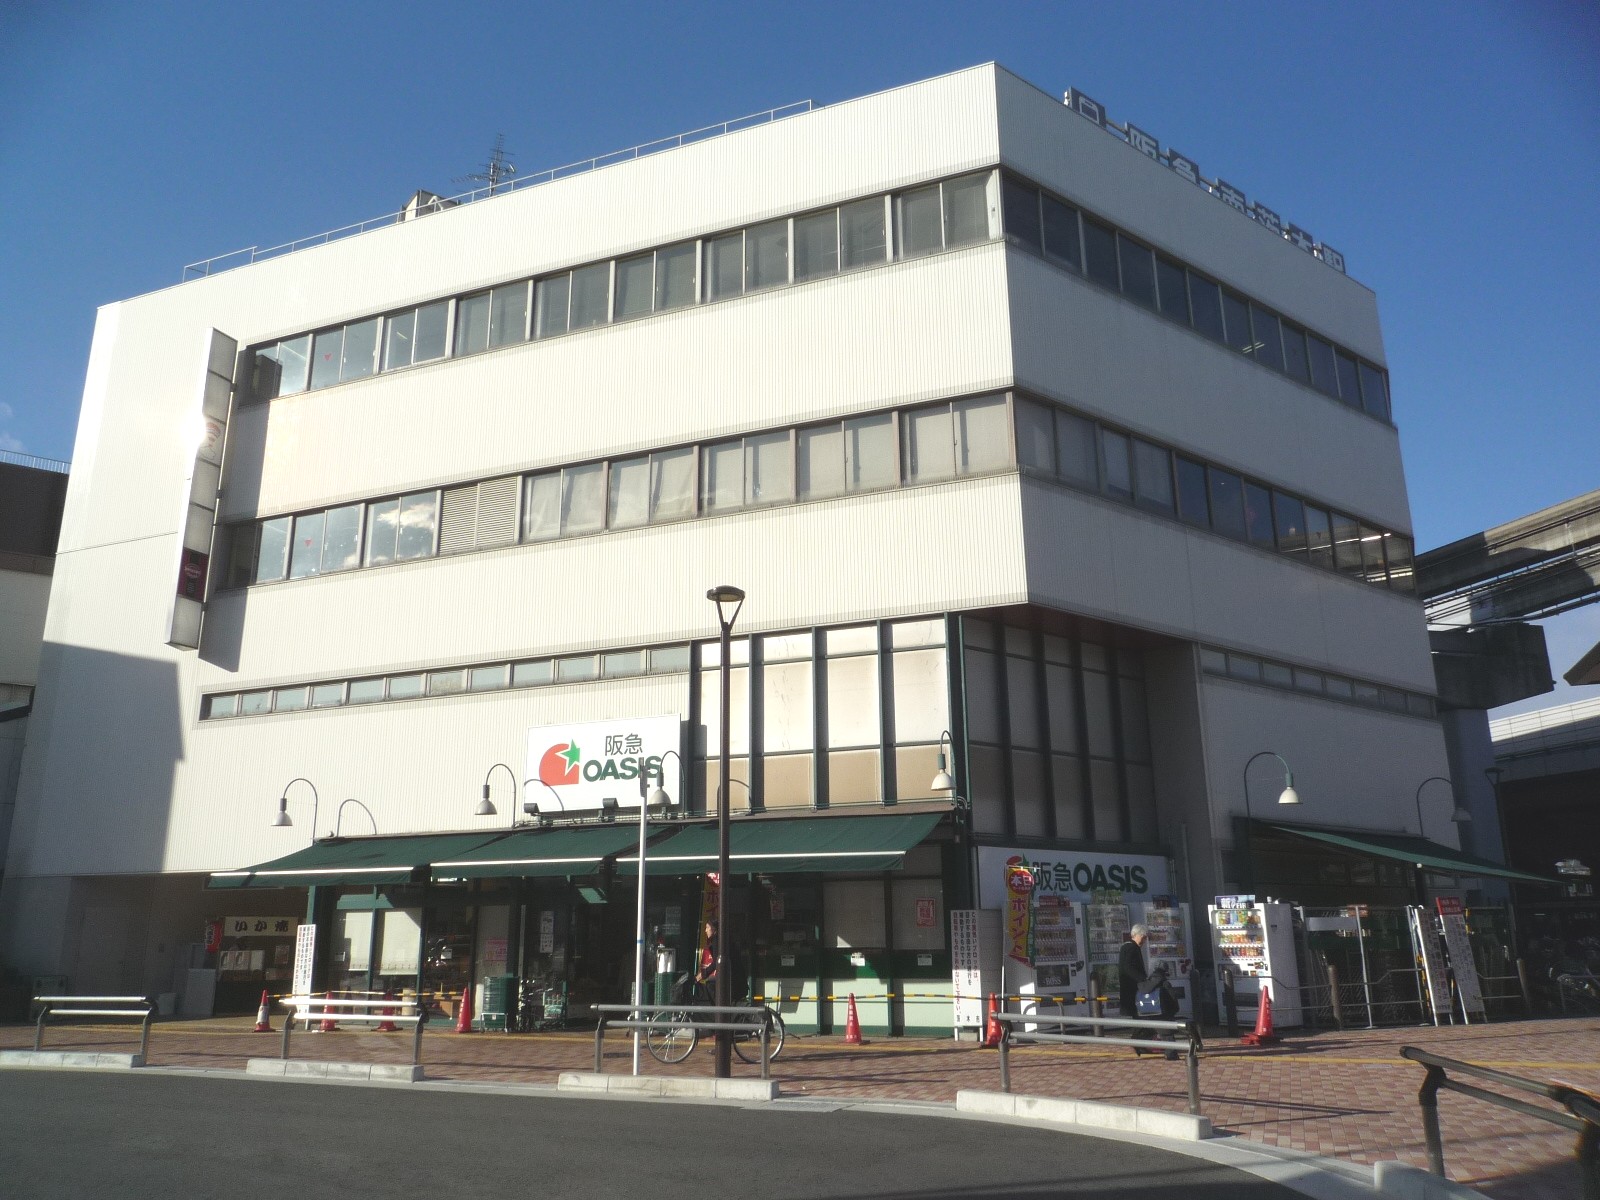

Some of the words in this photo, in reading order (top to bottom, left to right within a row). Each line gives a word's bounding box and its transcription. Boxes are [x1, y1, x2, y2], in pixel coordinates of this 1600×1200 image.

[605, 733, 643, 756] 阪急
[1032, 861, 1074, 892] 阪急
[1073, 863, 1149, 894] OASIS
